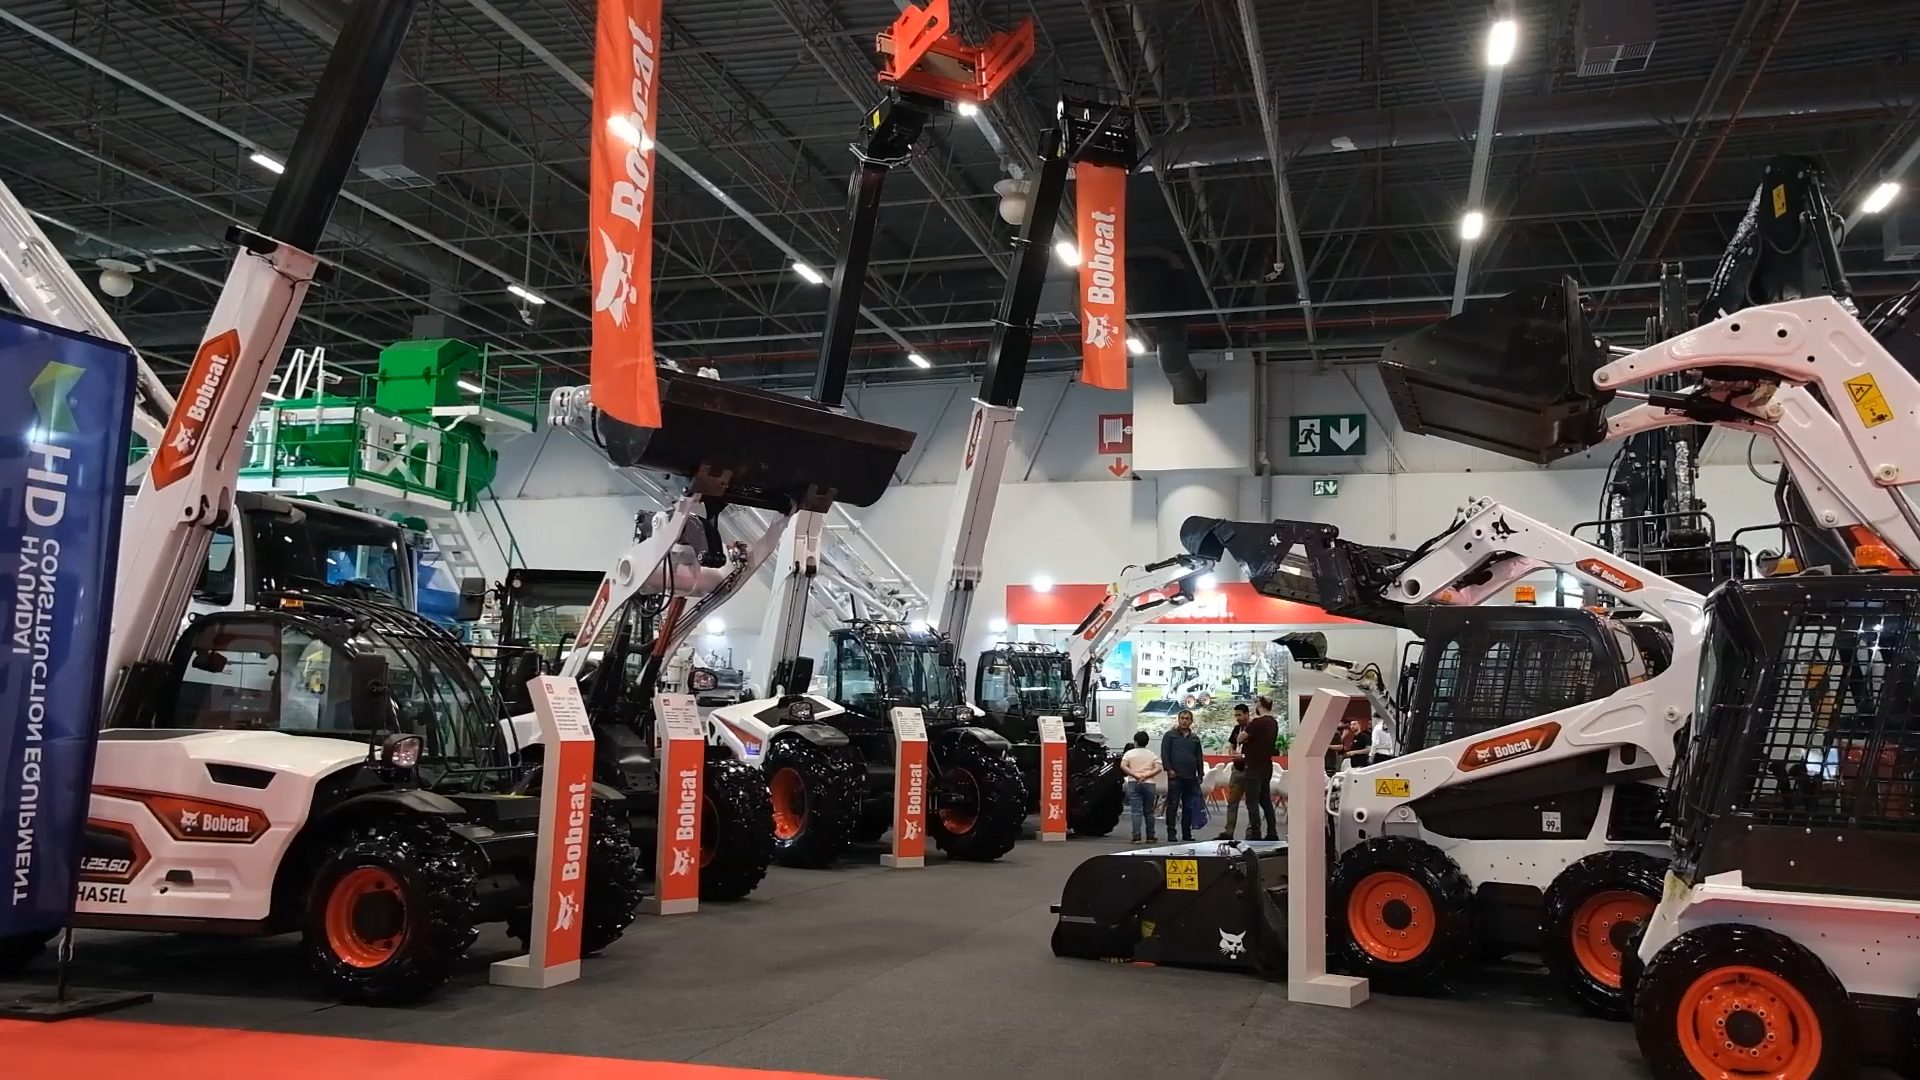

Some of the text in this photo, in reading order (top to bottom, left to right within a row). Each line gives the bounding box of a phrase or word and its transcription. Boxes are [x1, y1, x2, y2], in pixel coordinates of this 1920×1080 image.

[611, 16, 654, 232] Bobcat
[1088, 211, 1116, 304] Bobcat
[187, 354, 228, 422] Bobcat
[1601, 570, 1627, 588] Bobcat
[1494, 739, 1532, 758] Bobcat
[676, 769, 697, 840] Bobcat
[907, 763, 923, 814] Bobcat
[1050, 759, 1063, 800] Bobcat
[202, 814, 250, 832] Bobcat
[562, 781, 586, 881] Bobcat
[1546, 820, 1556, 830] 99
